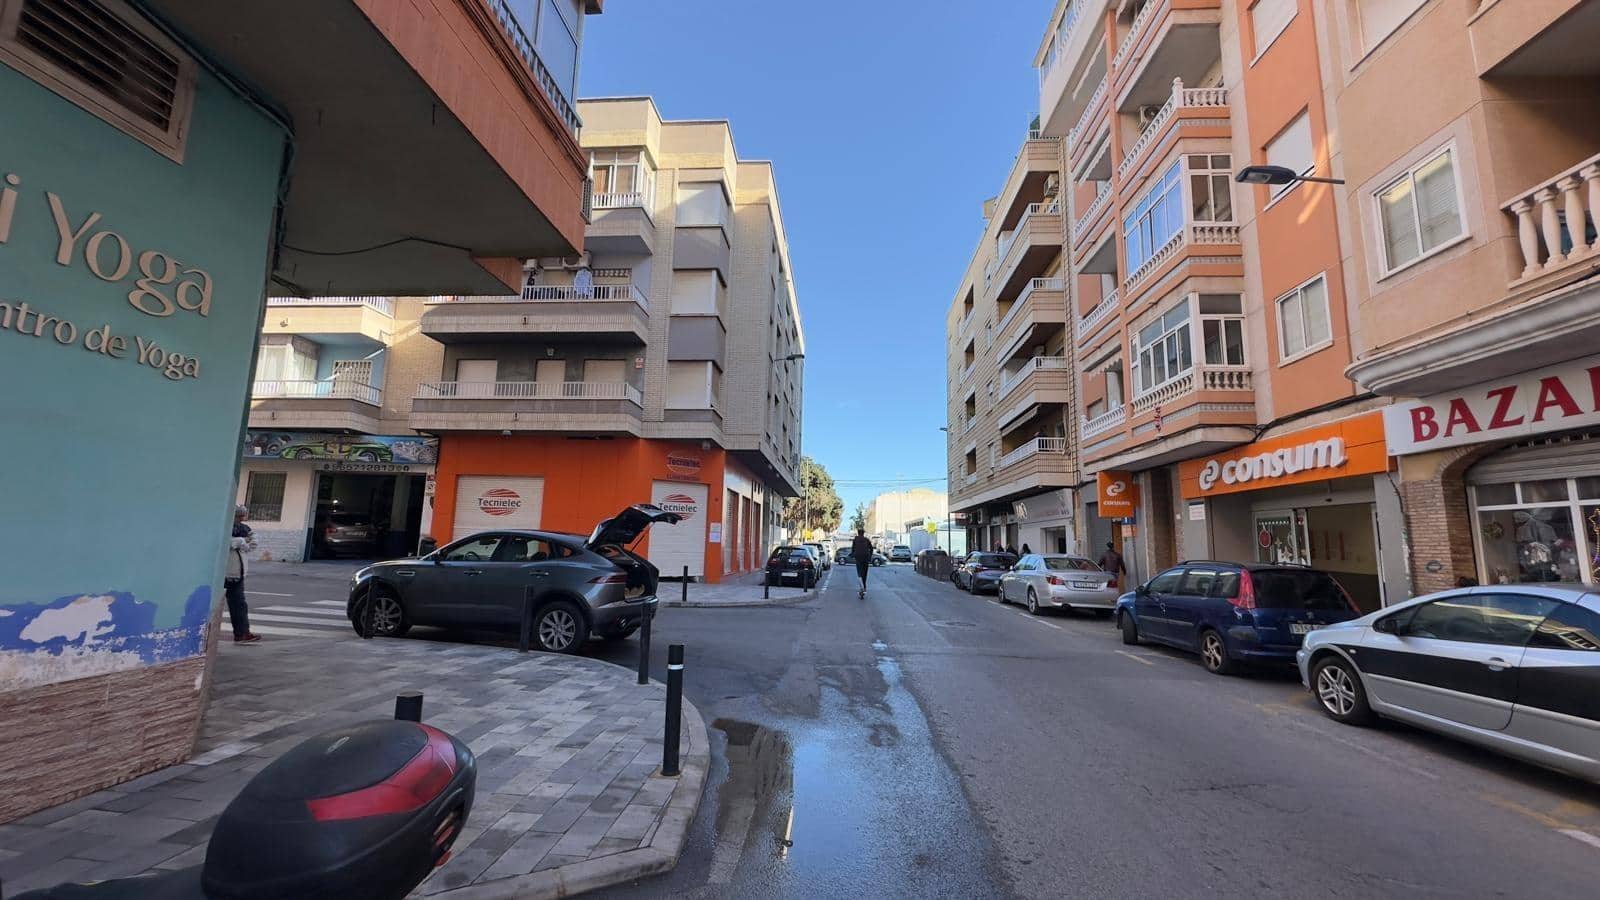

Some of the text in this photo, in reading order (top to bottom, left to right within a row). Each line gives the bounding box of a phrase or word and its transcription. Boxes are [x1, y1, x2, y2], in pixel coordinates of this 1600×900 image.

[45, 191, 213, 317] Yoga
[84, 324, 127, 359] de
[135, 335, 200, 381] Yoga
[1222, 437, 1348, 485] consum
[478, 497, 521, 508] Tecnielec
[658, 502, 698, 512] Tecnielec
